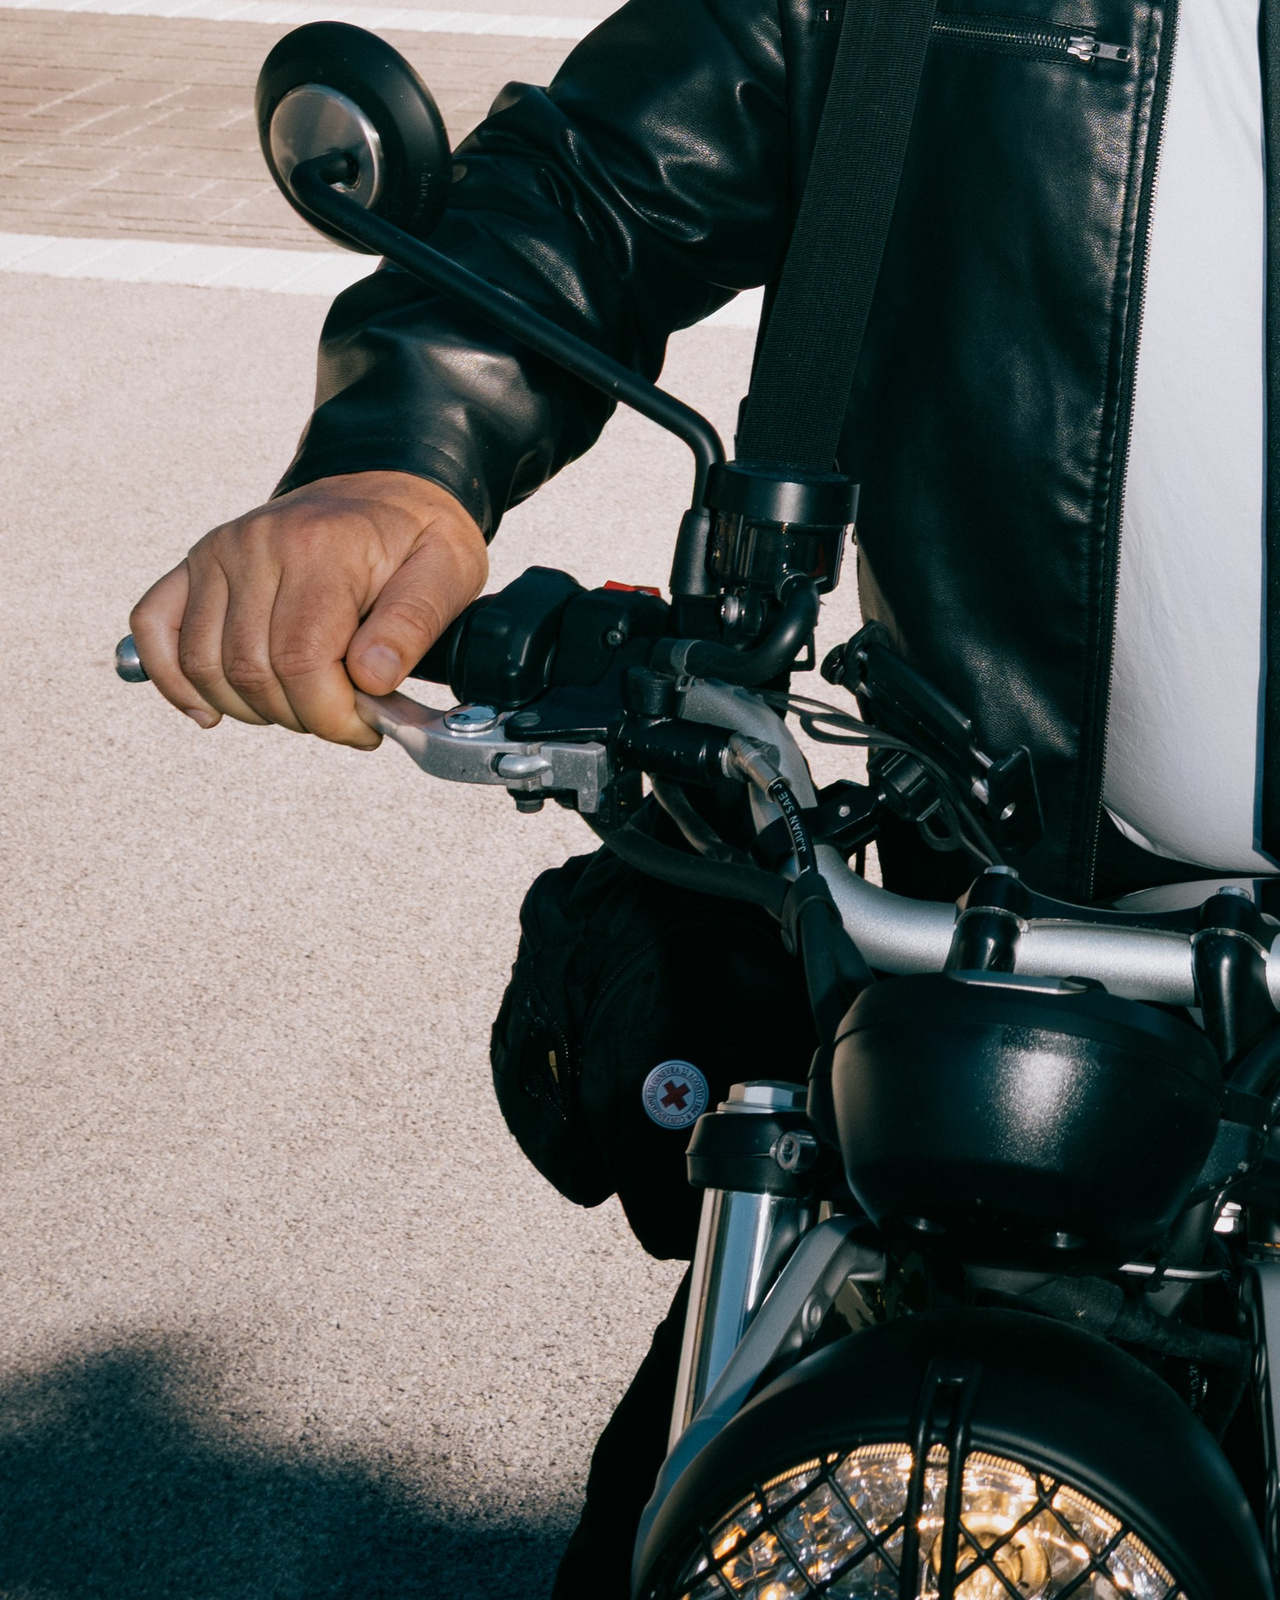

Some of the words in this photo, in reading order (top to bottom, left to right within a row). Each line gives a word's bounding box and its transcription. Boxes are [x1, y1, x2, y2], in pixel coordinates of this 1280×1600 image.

[778, 791, 795, 814] SAE
[789, 815, 807, 852] J.JUAN
[687, 1073, 704, 1100] AGOSTO
